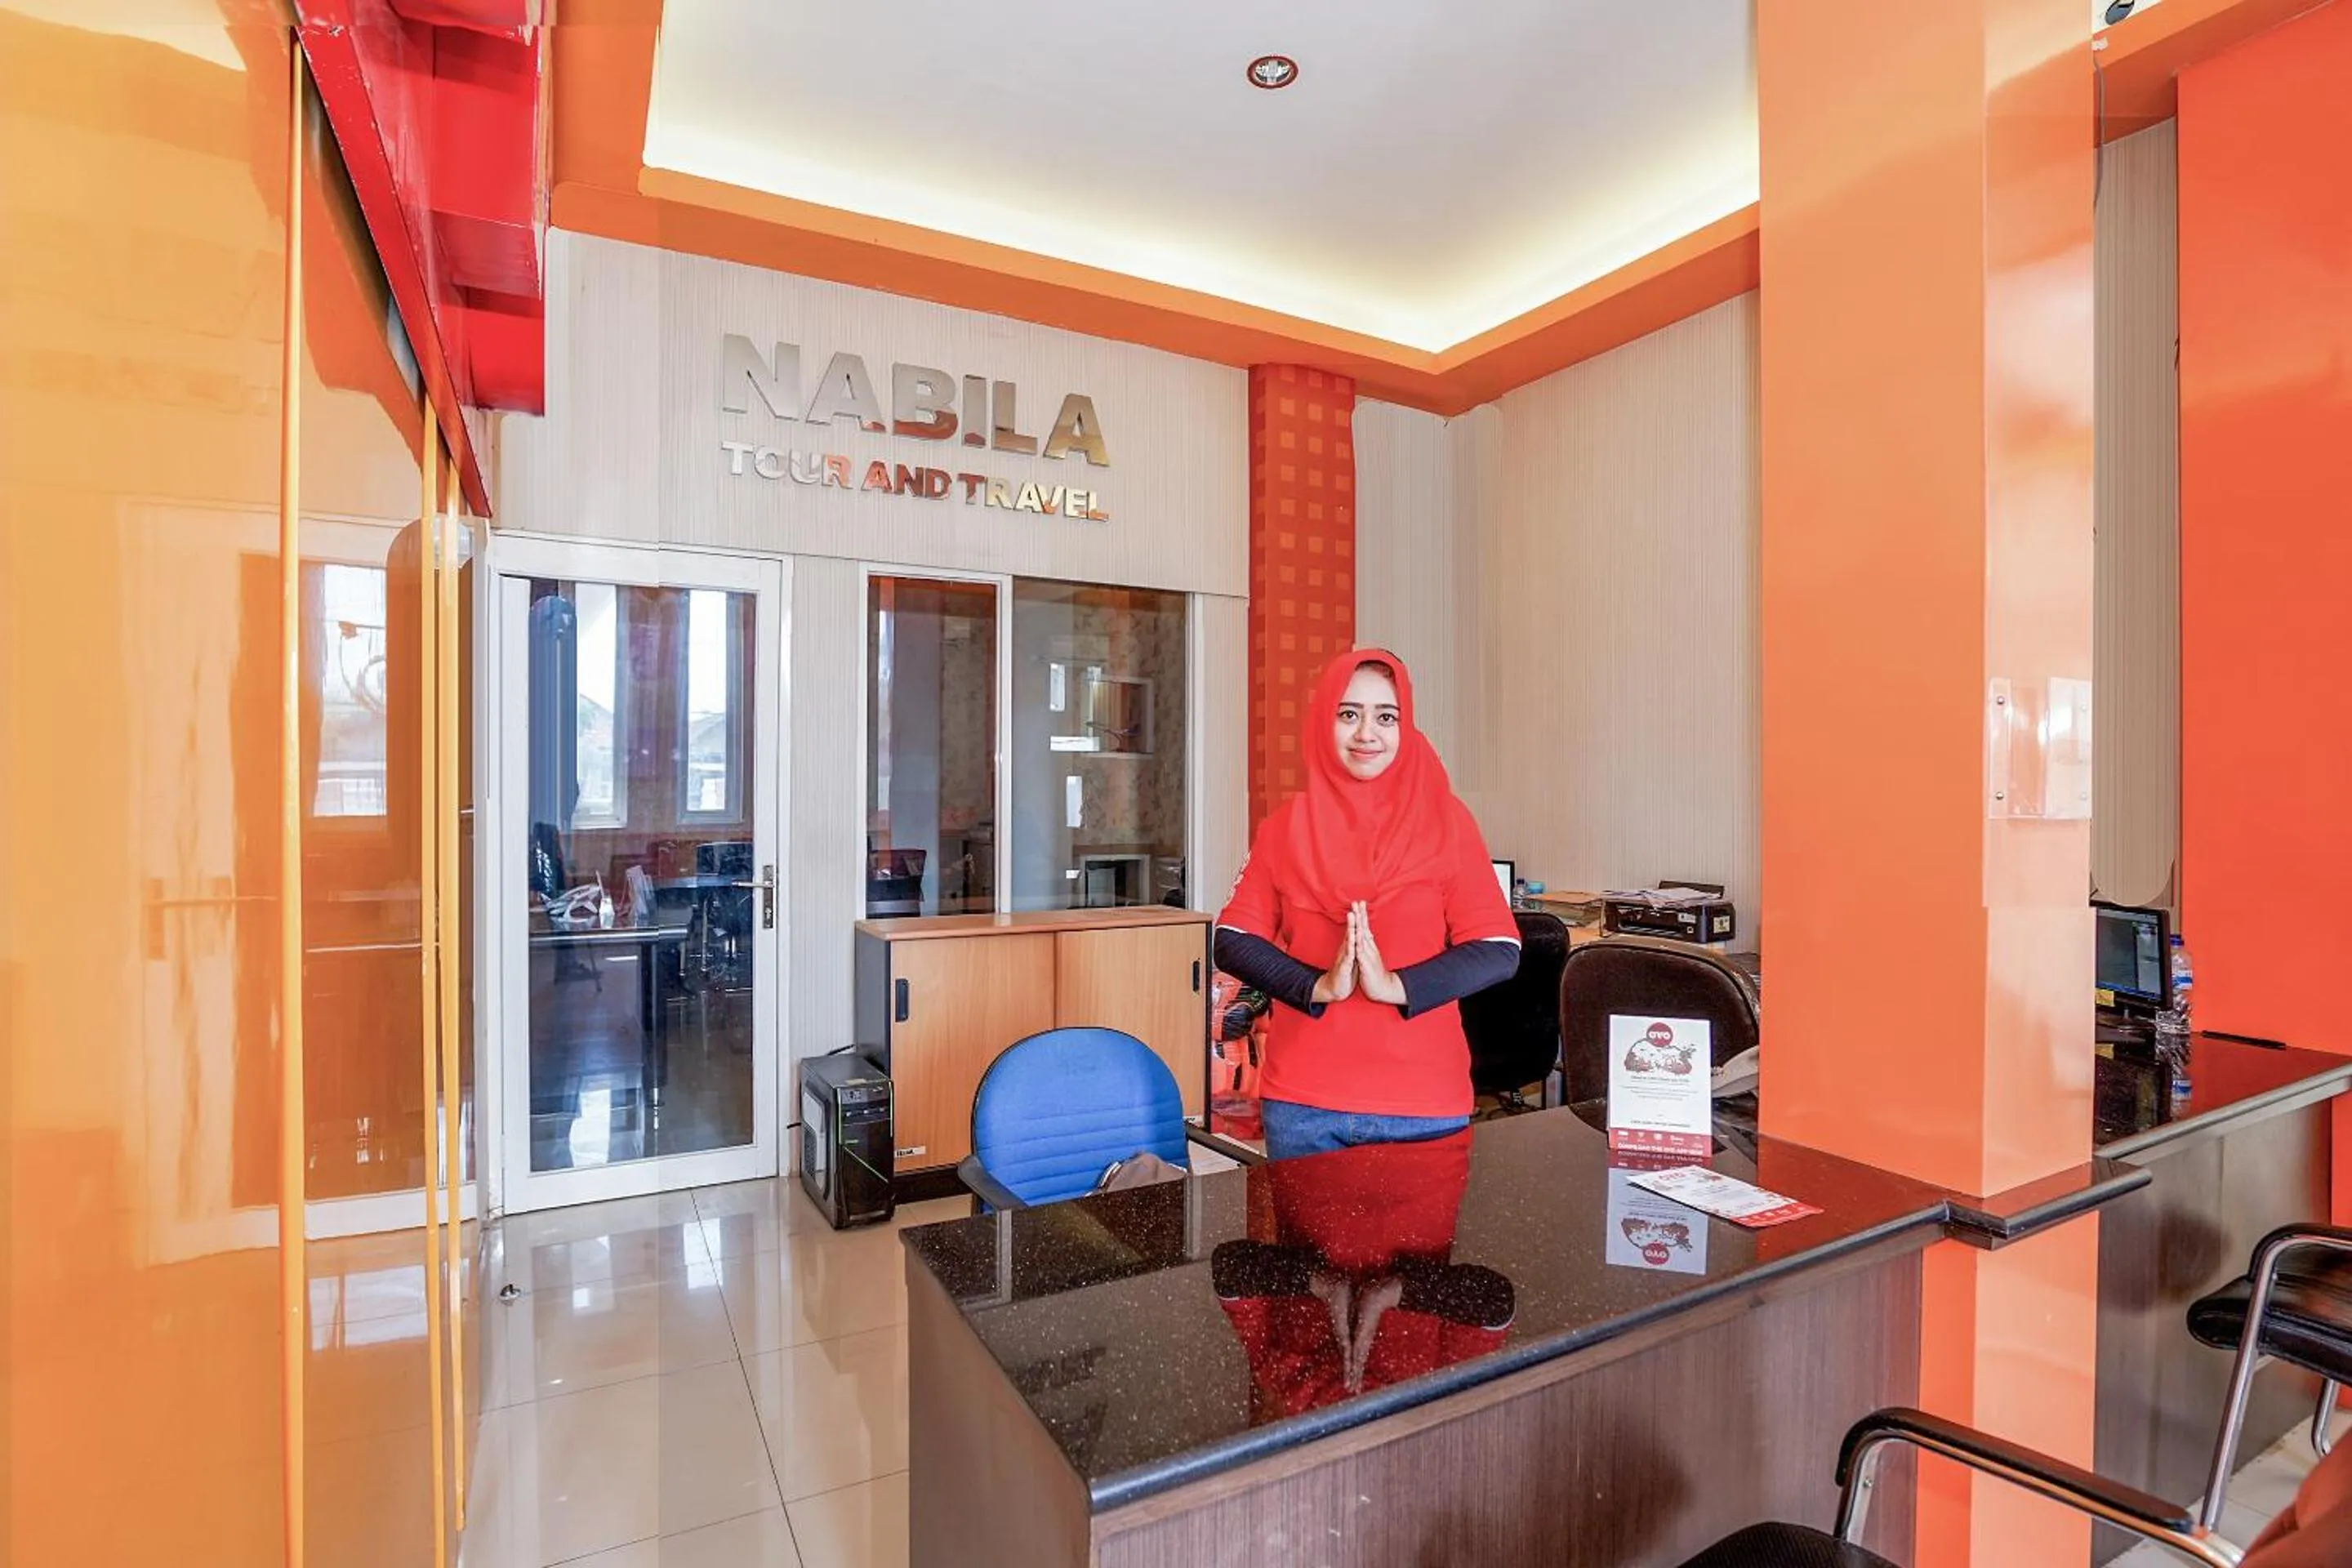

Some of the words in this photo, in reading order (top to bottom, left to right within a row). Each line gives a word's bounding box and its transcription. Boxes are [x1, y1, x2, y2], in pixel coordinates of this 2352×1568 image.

[723, 333, 1110, 467] NABILA
[721, 441, 853, 490] TOUR
[861, 459, 953, 500] AND
[958, 473, 1111, 521] TRAVEL
